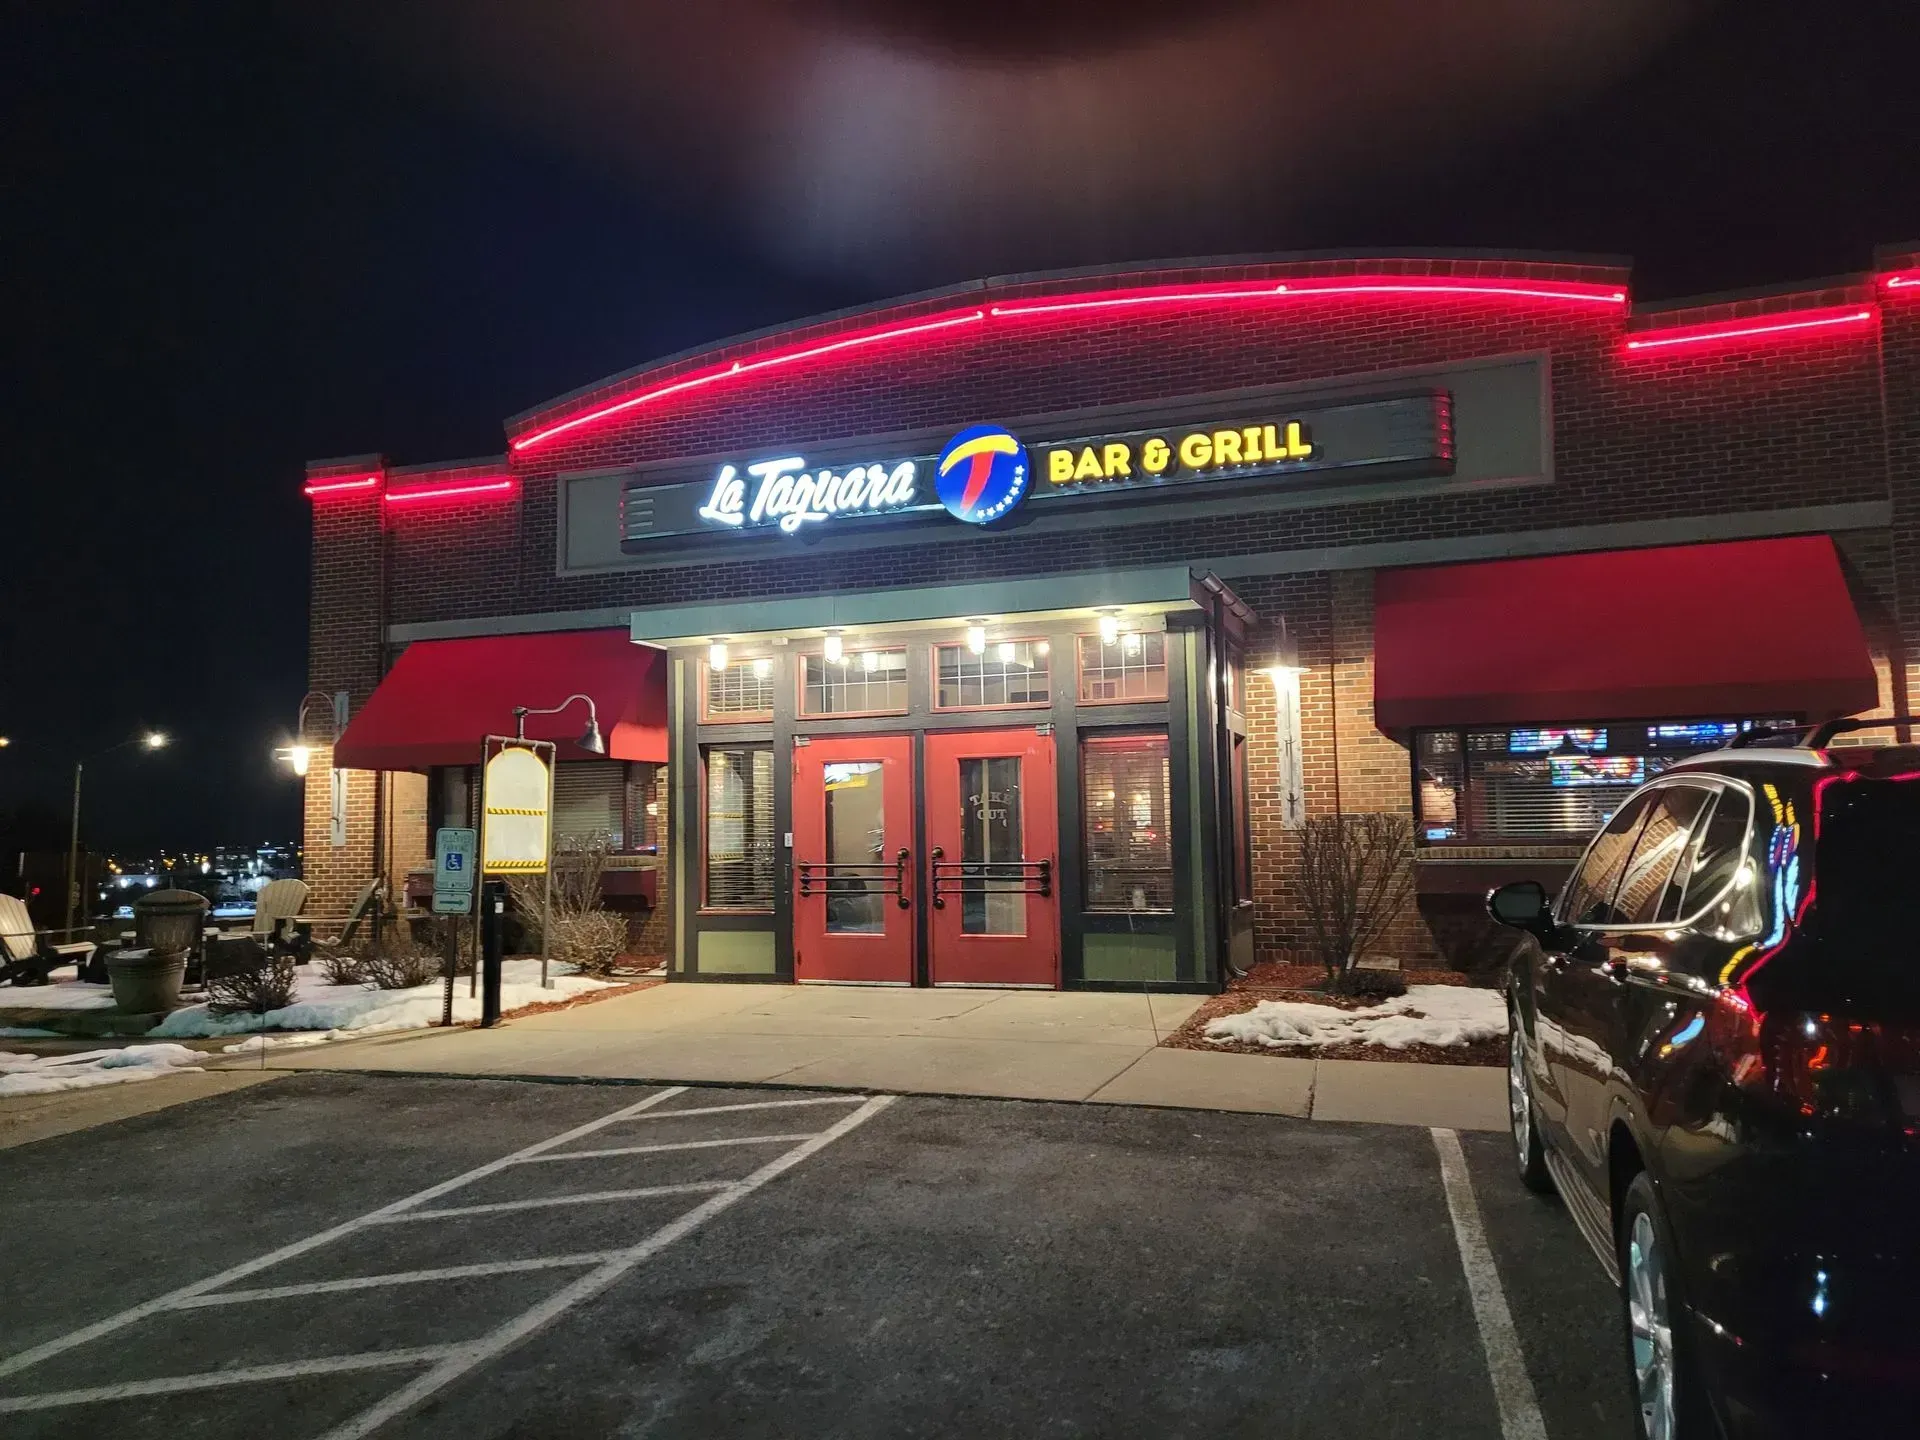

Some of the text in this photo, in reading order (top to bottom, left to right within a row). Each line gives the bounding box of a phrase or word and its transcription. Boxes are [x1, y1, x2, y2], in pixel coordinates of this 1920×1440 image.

[1049, 422, 1313, 482] BAR & GRILL
[699, 457, 915, 532] La Taguara
[977, 808, 1008, 820] OUT
